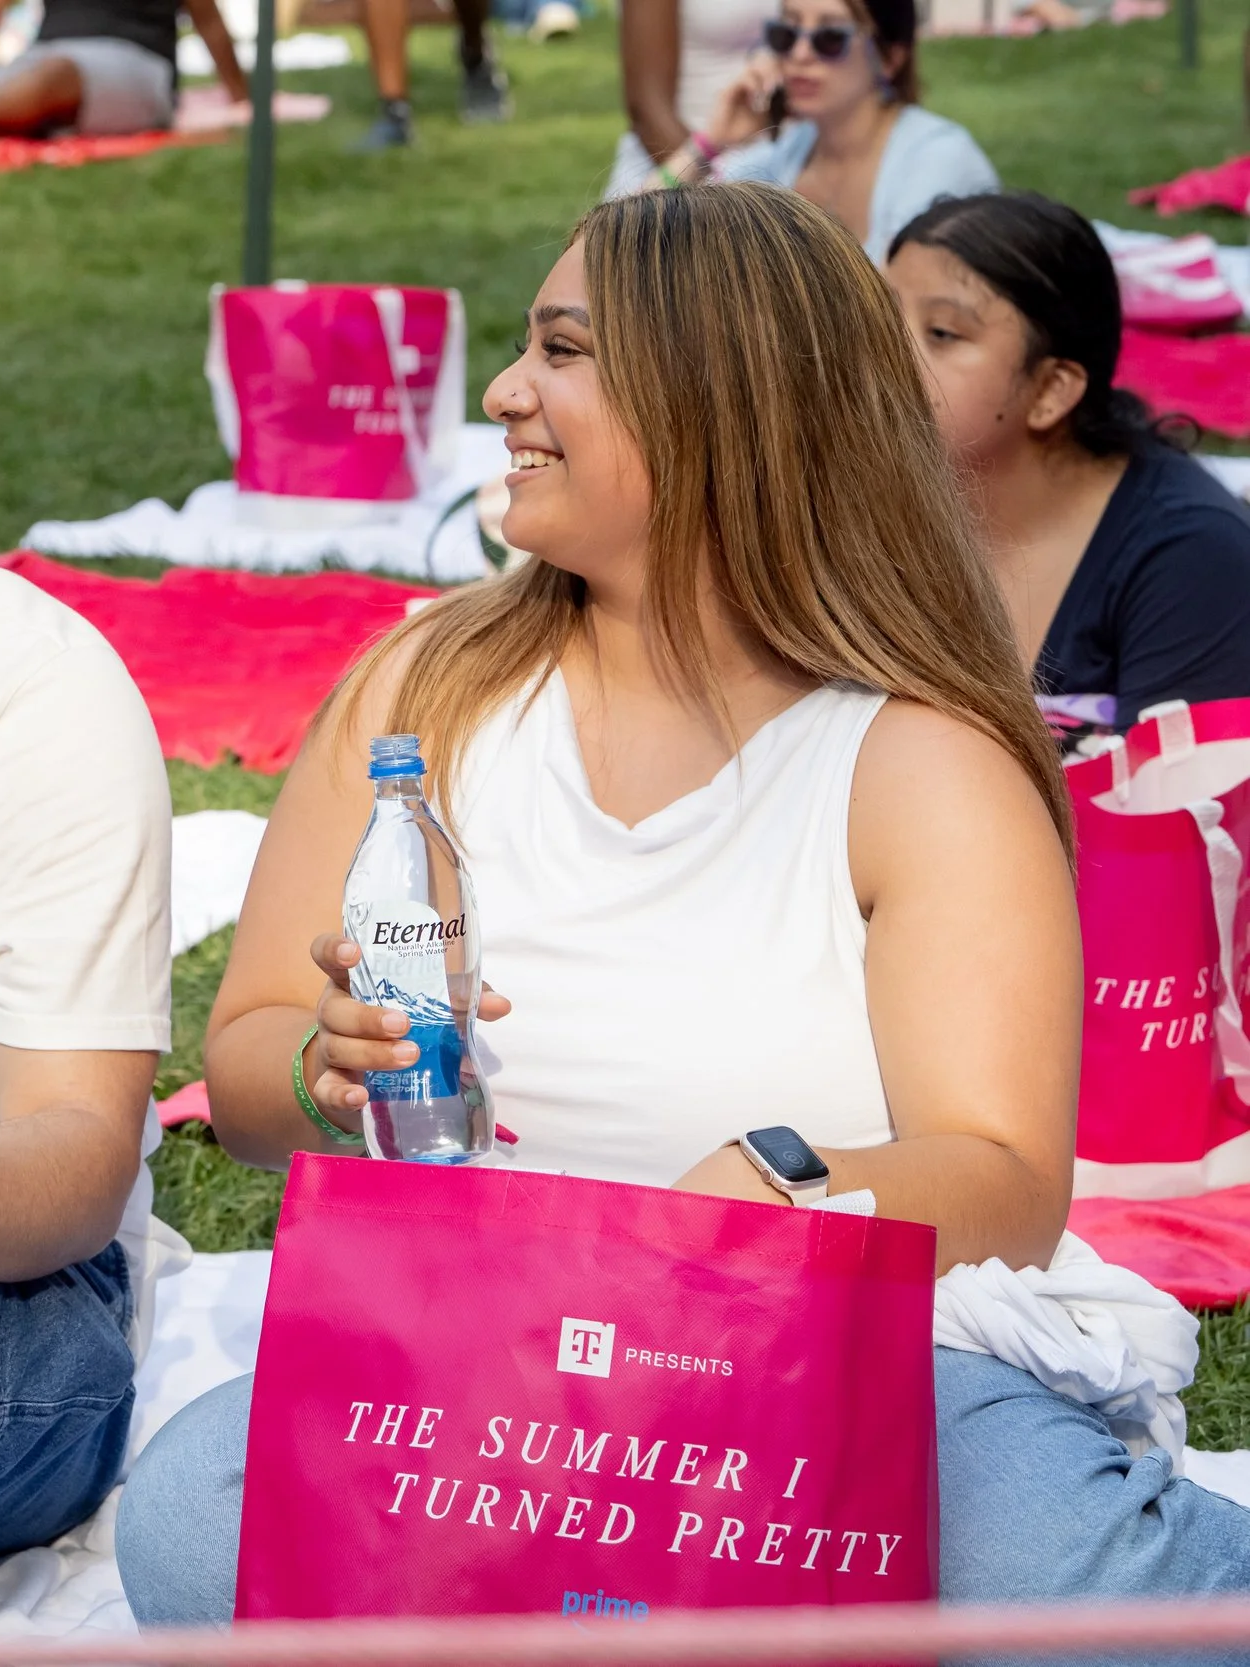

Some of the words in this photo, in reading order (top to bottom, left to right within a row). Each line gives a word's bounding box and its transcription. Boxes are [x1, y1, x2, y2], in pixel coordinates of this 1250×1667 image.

[372, 913, 466, 945] Eternal
[387, 943, 424, 952] Naturally
[398, 949, 423, 958] Spring
[425, 948, 448, 956] Water
[1094, 976, 1176, 1009] THE
[1140, 1012, 1215, 1052] TUR
[625, 1347, 733, 1377] PRESENTS
[344, 1401, 444, 1449] THE
[478, 1416, 750, 1492] SUMMER
[782, 1457, 809, 1499] I
[388, 1472, 636, 1545] TURNED
[667, 1511, 903, 1576] PRETTY
[561, 1589, 649, 1624] prime
